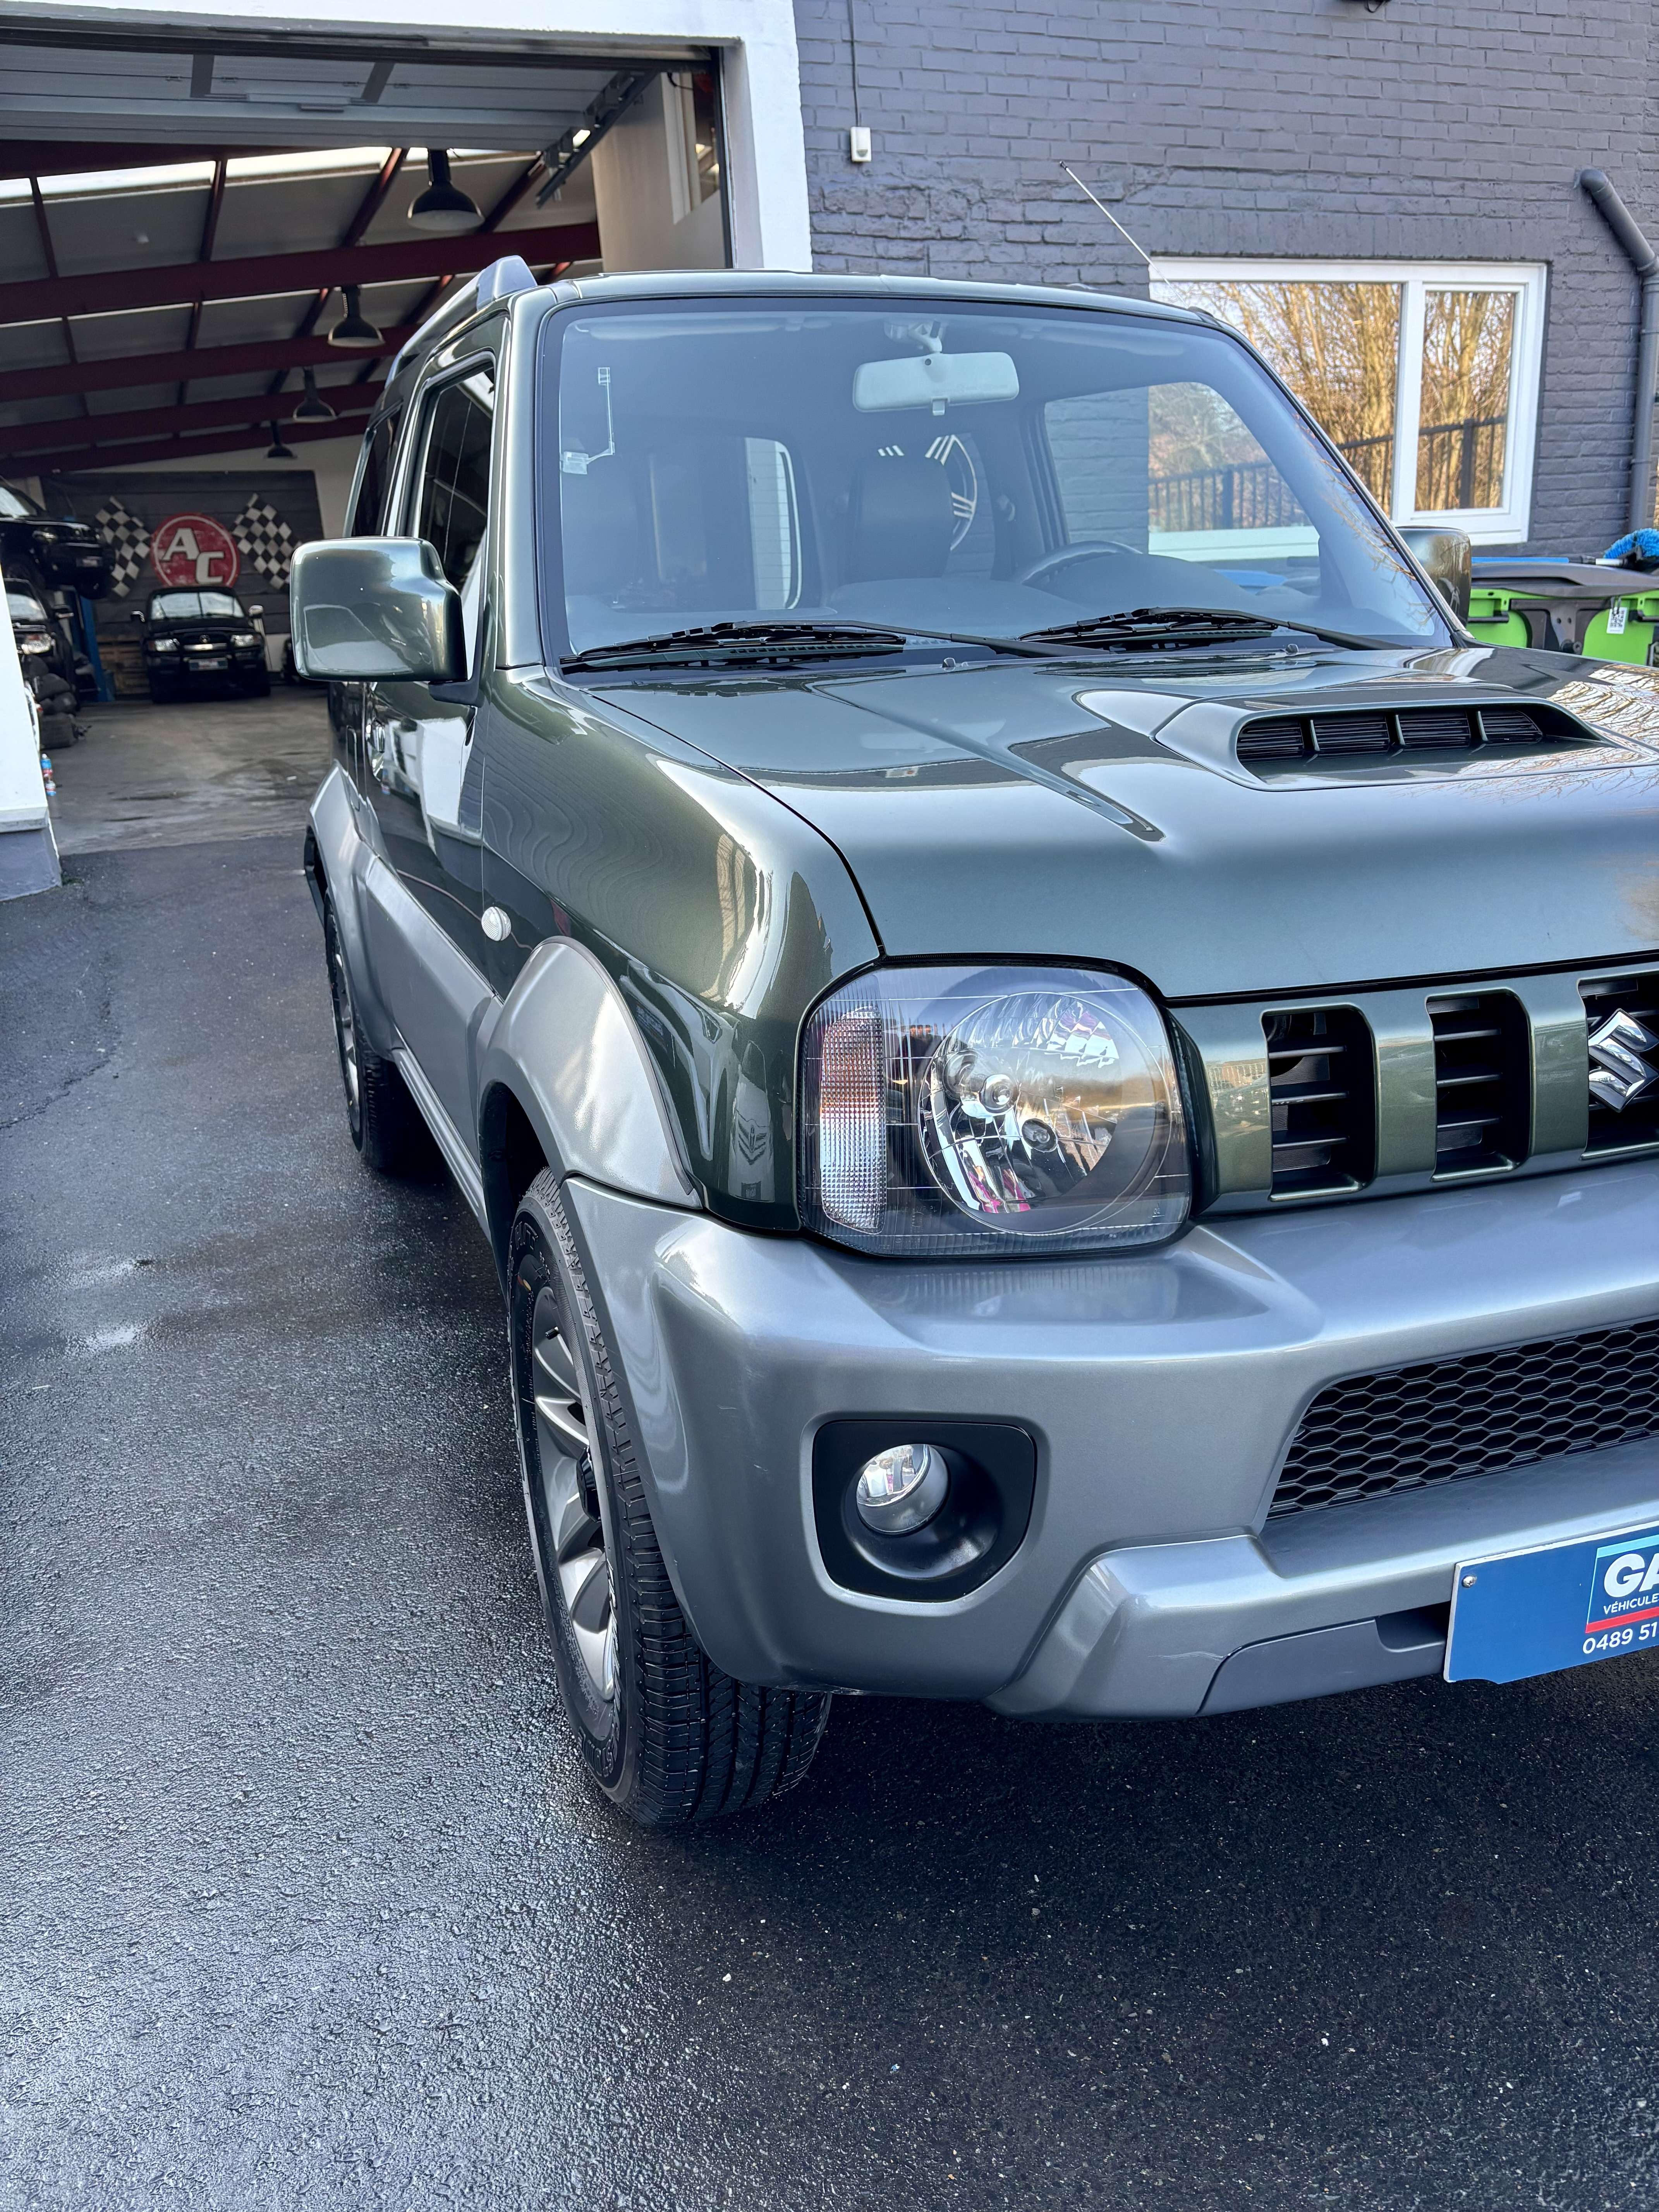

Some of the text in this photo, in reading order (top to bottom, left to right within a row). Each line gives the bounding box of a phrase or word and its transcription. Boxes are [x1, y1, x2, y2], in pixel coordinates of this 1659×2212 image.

[162, 527, 224, 584] AC
[1603, 1593, 1659, 1614] VÉHICULE
[1583, 1621, 1657, 1654] 0489 51
